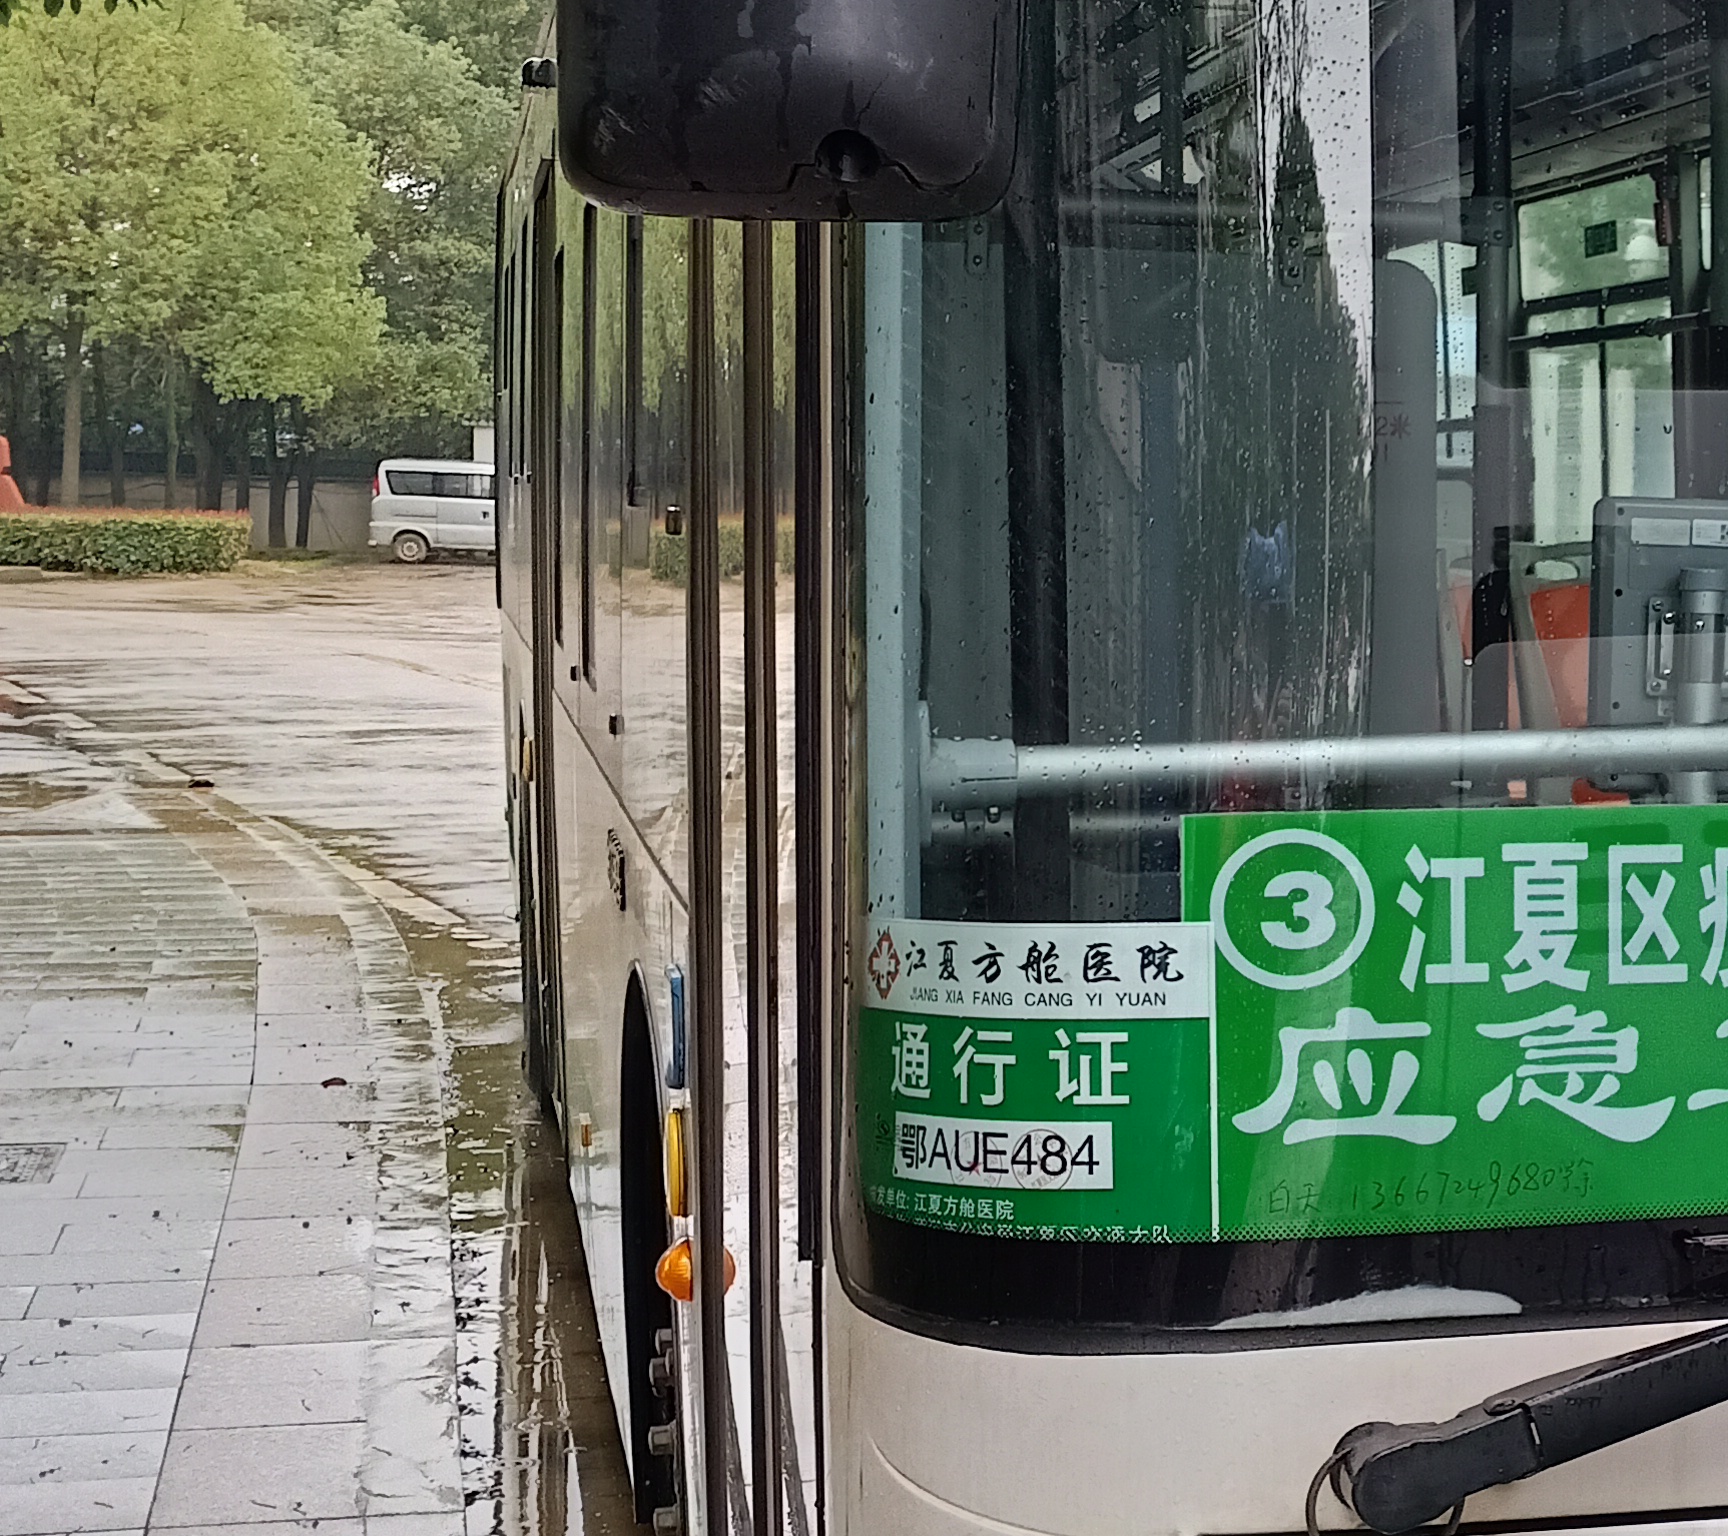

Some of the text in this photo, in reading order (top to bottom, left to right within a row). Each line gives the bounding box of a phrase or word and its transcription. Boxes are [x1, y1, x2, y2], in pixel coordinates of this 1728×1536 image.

[905, 939, 1185, 985] 江夏方舱医院
[909, 986, 1166, 1007] JIANG XIA FANG CANG YI YUAN
[891, 1020, 1130, 1107] 通行证
[900, 1122, 1100, 1177] 鄂AUE484
[914, 1191, 1015, 1221] 江夏方舱医院
